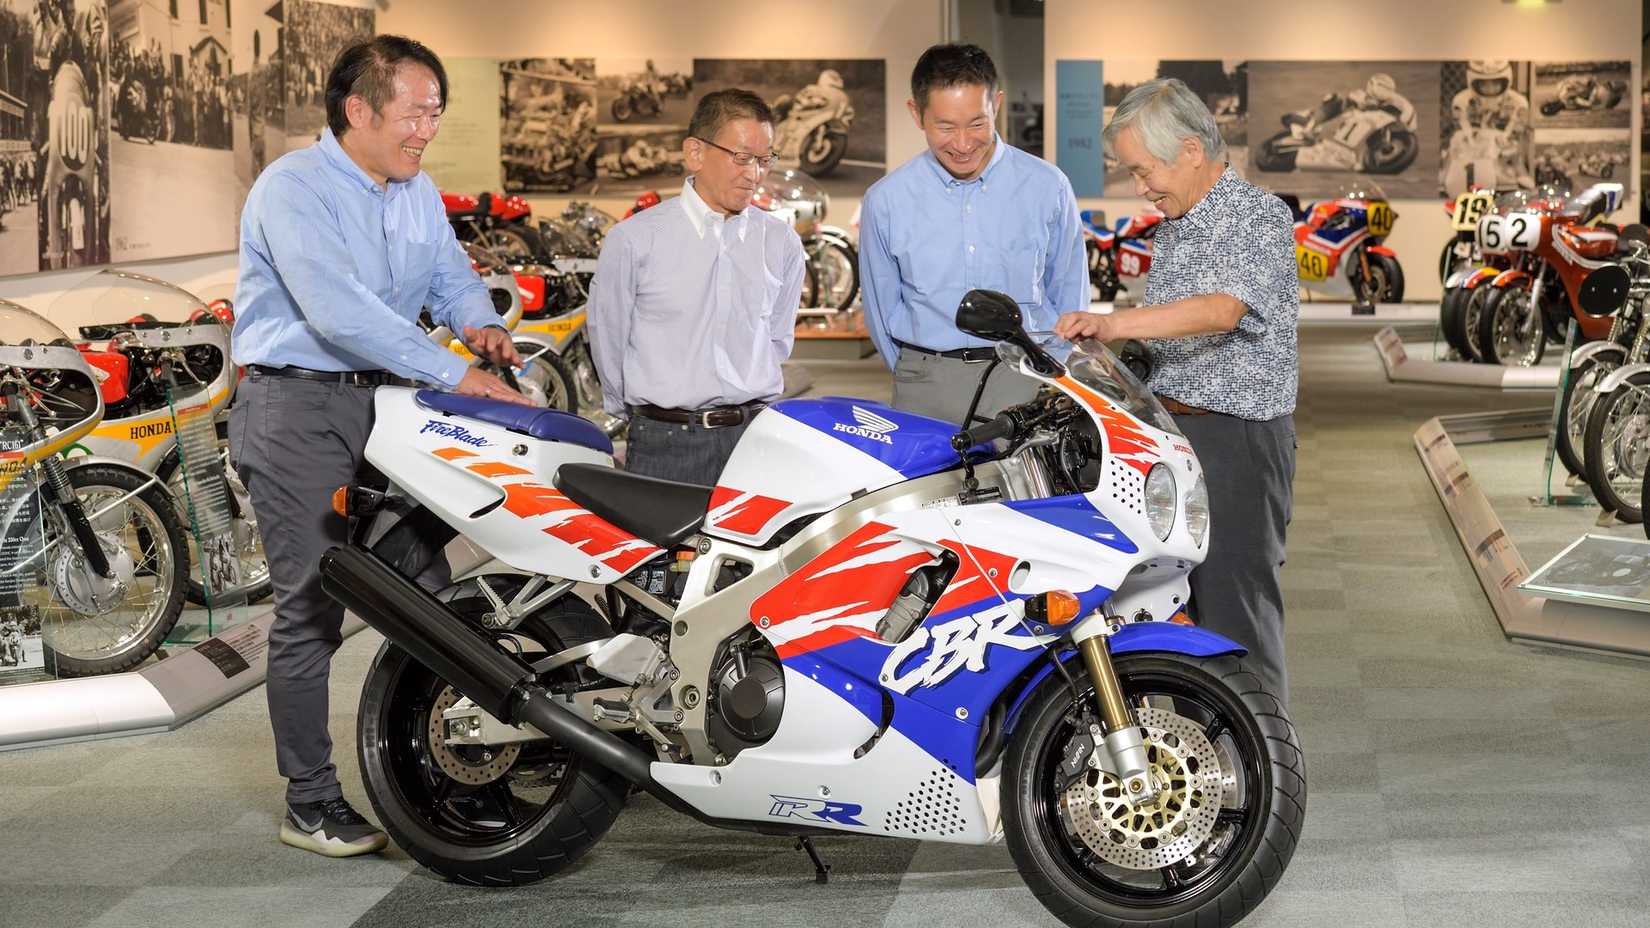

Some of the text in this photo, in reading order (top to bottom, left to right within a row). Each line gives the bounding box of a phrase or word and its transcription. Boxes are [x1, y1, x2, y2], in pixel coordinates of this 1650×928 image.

[1371, 206, 1393, 232] 40
[1120, 251, 1140, 276] 99
[1300, 251, 1323, 278] 40
[130, 421, 172, 440] HONDA
[832, 422, 894, 446] HONDA
[878, 597, 1062, 696] CBR
